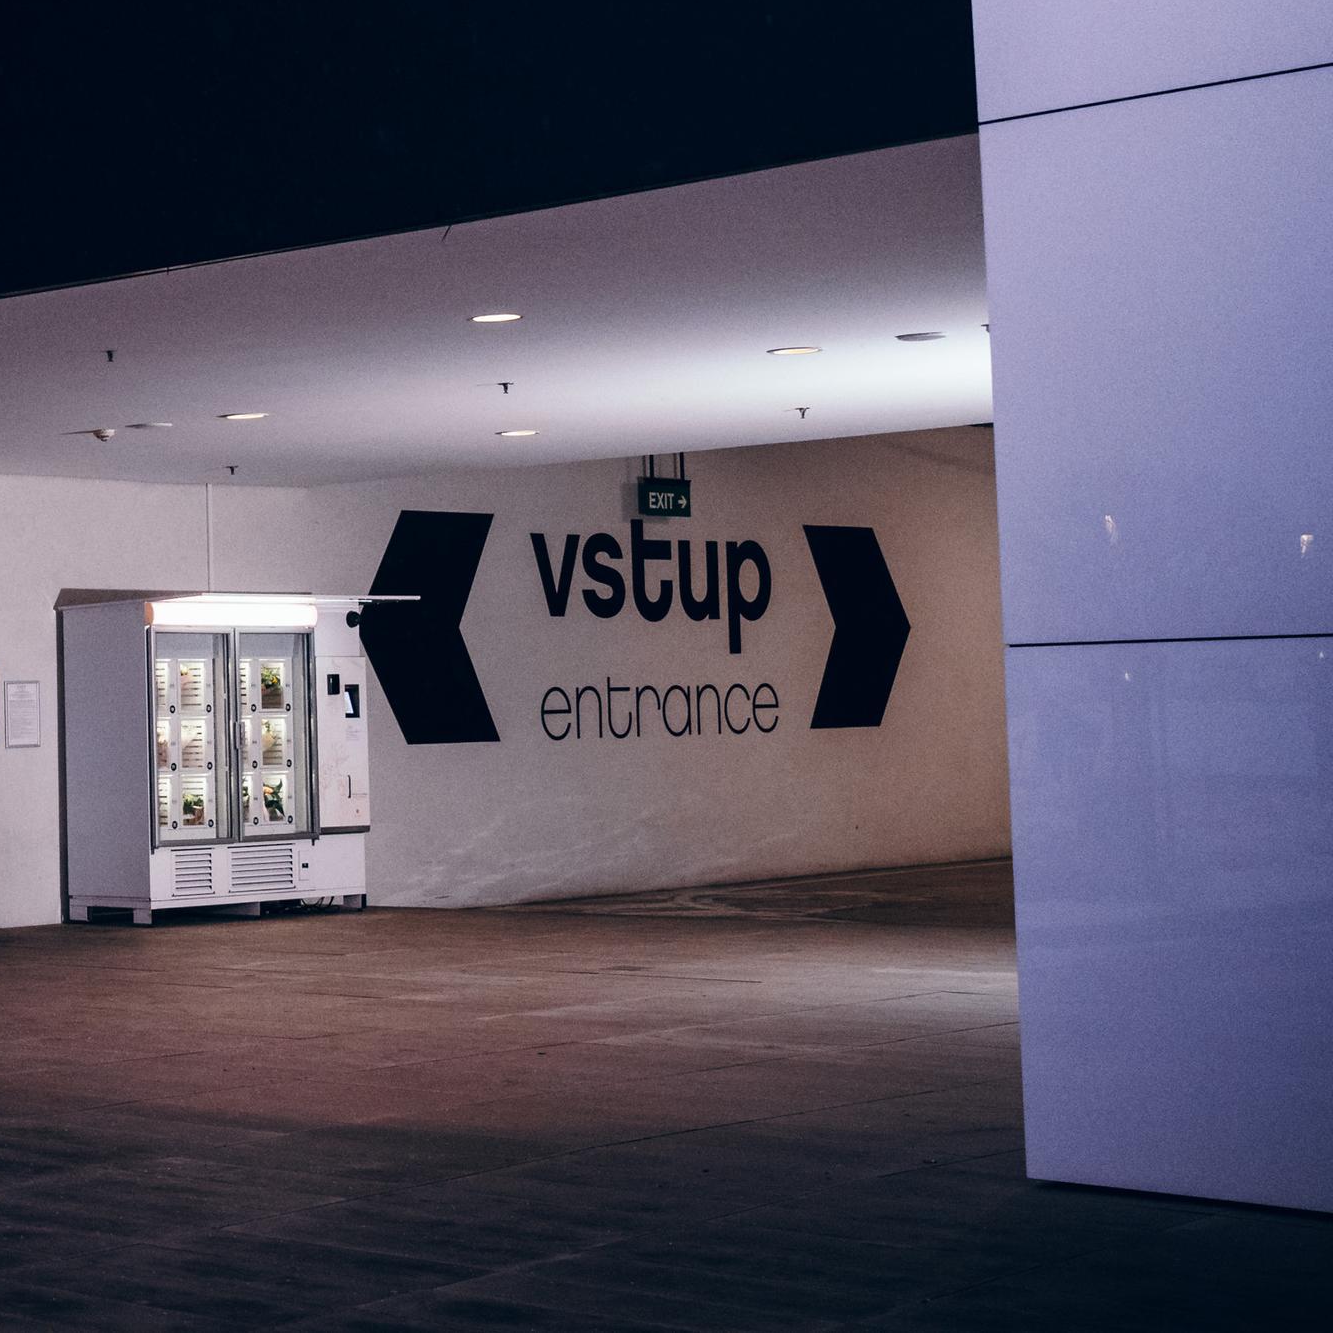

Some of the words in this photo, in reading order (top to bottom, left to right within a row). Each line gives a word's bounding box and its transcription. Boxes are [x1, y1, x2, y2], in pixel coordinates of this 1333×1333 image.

[648, 491, 674, 509] EXIT
[530, 519, 771, 654] vstup
[541, 676, 779, 740] entrance
